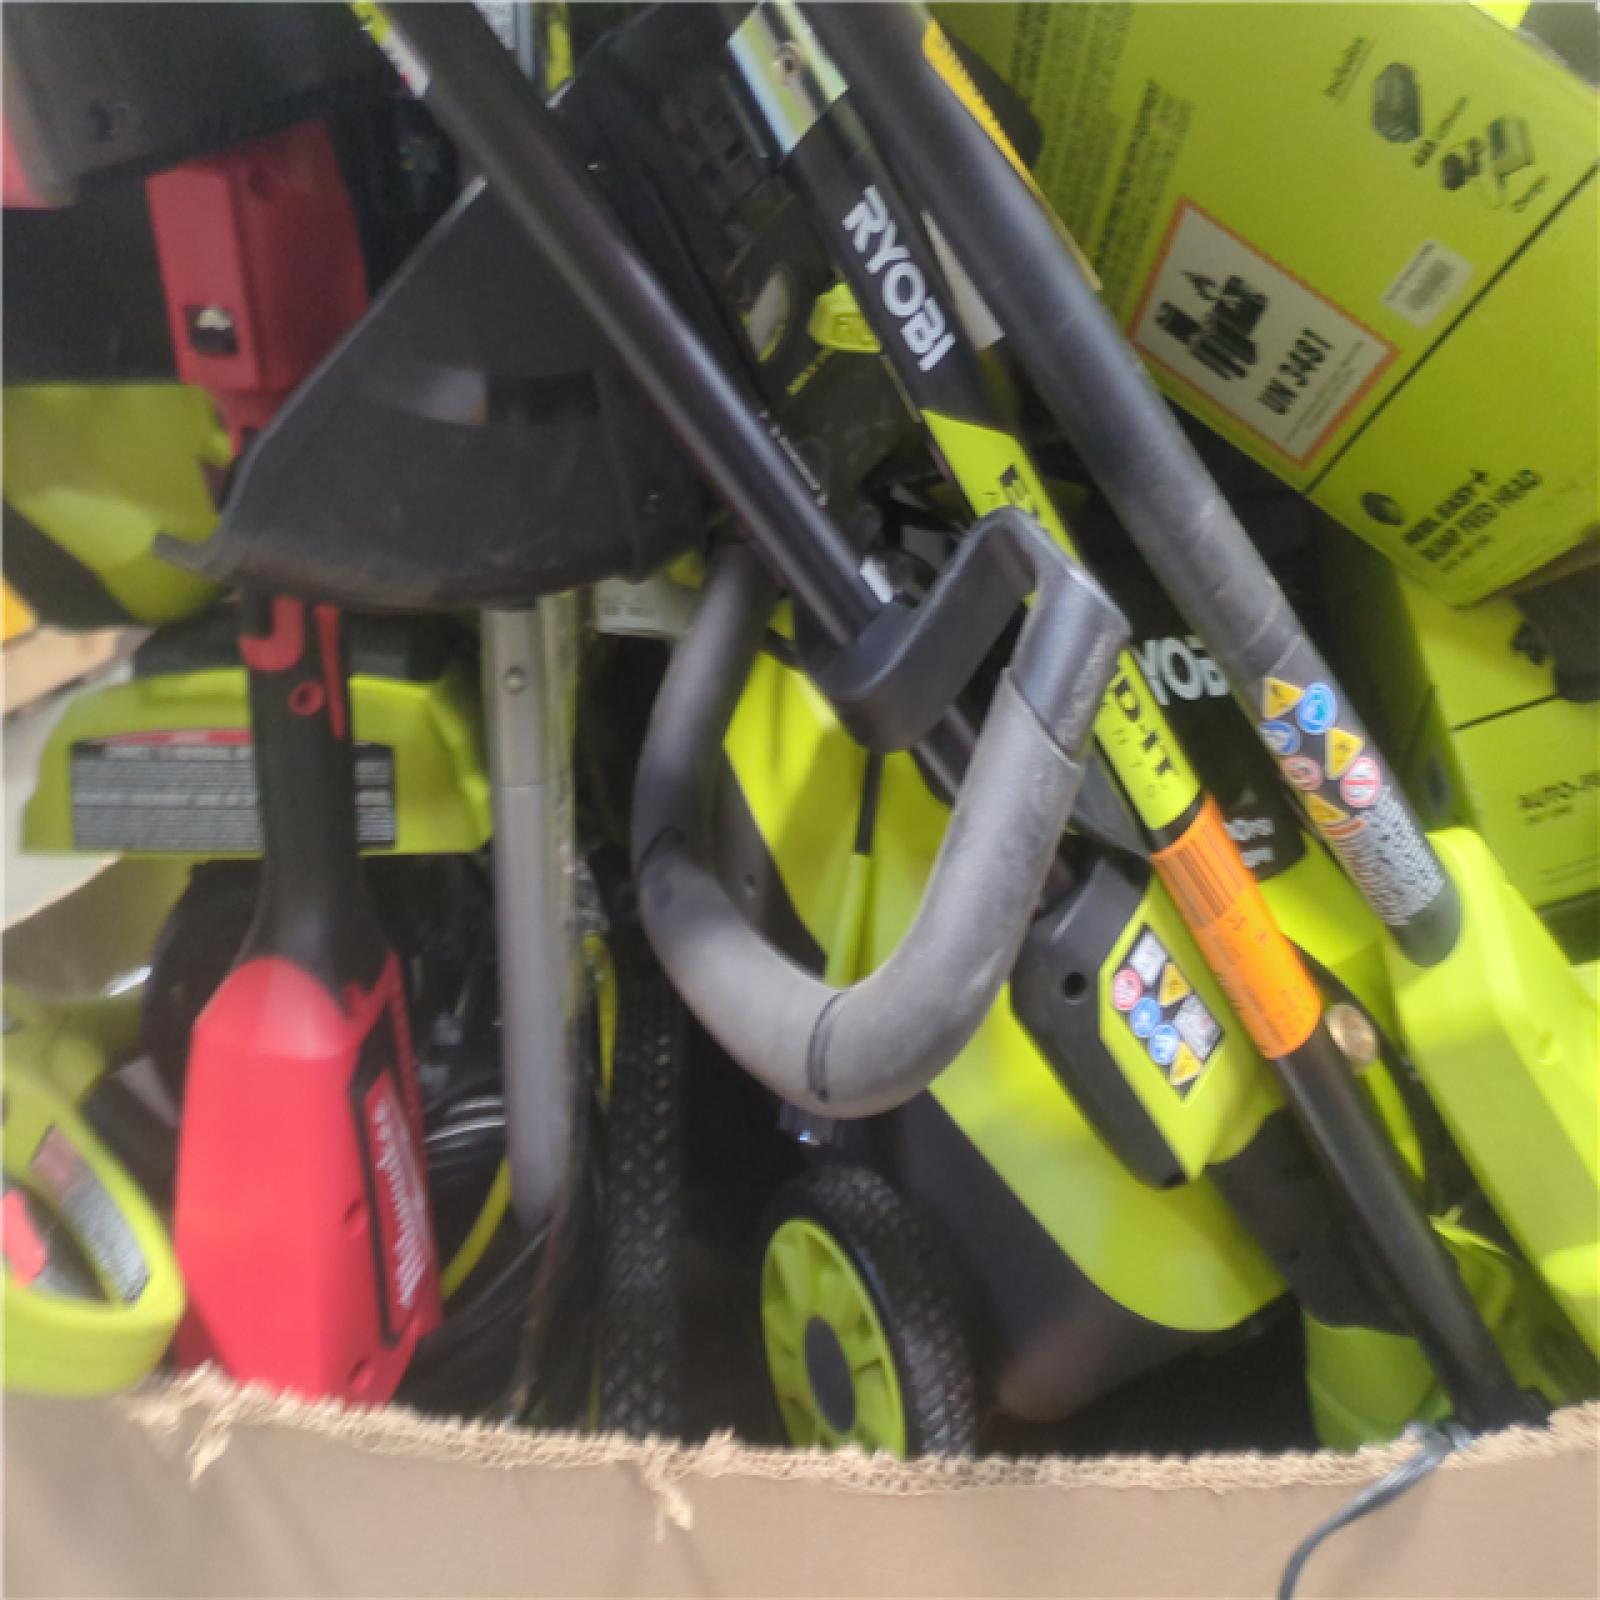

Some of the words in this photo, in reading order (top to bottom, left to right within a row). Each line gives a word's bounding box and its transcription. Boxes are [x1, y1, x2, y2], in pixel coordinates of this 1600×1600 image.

[842, 185, 956, 371] RYOBI
[1257, 376, 1299, 416] UN
[373, 1101, 427, 1308] Milwaukee
